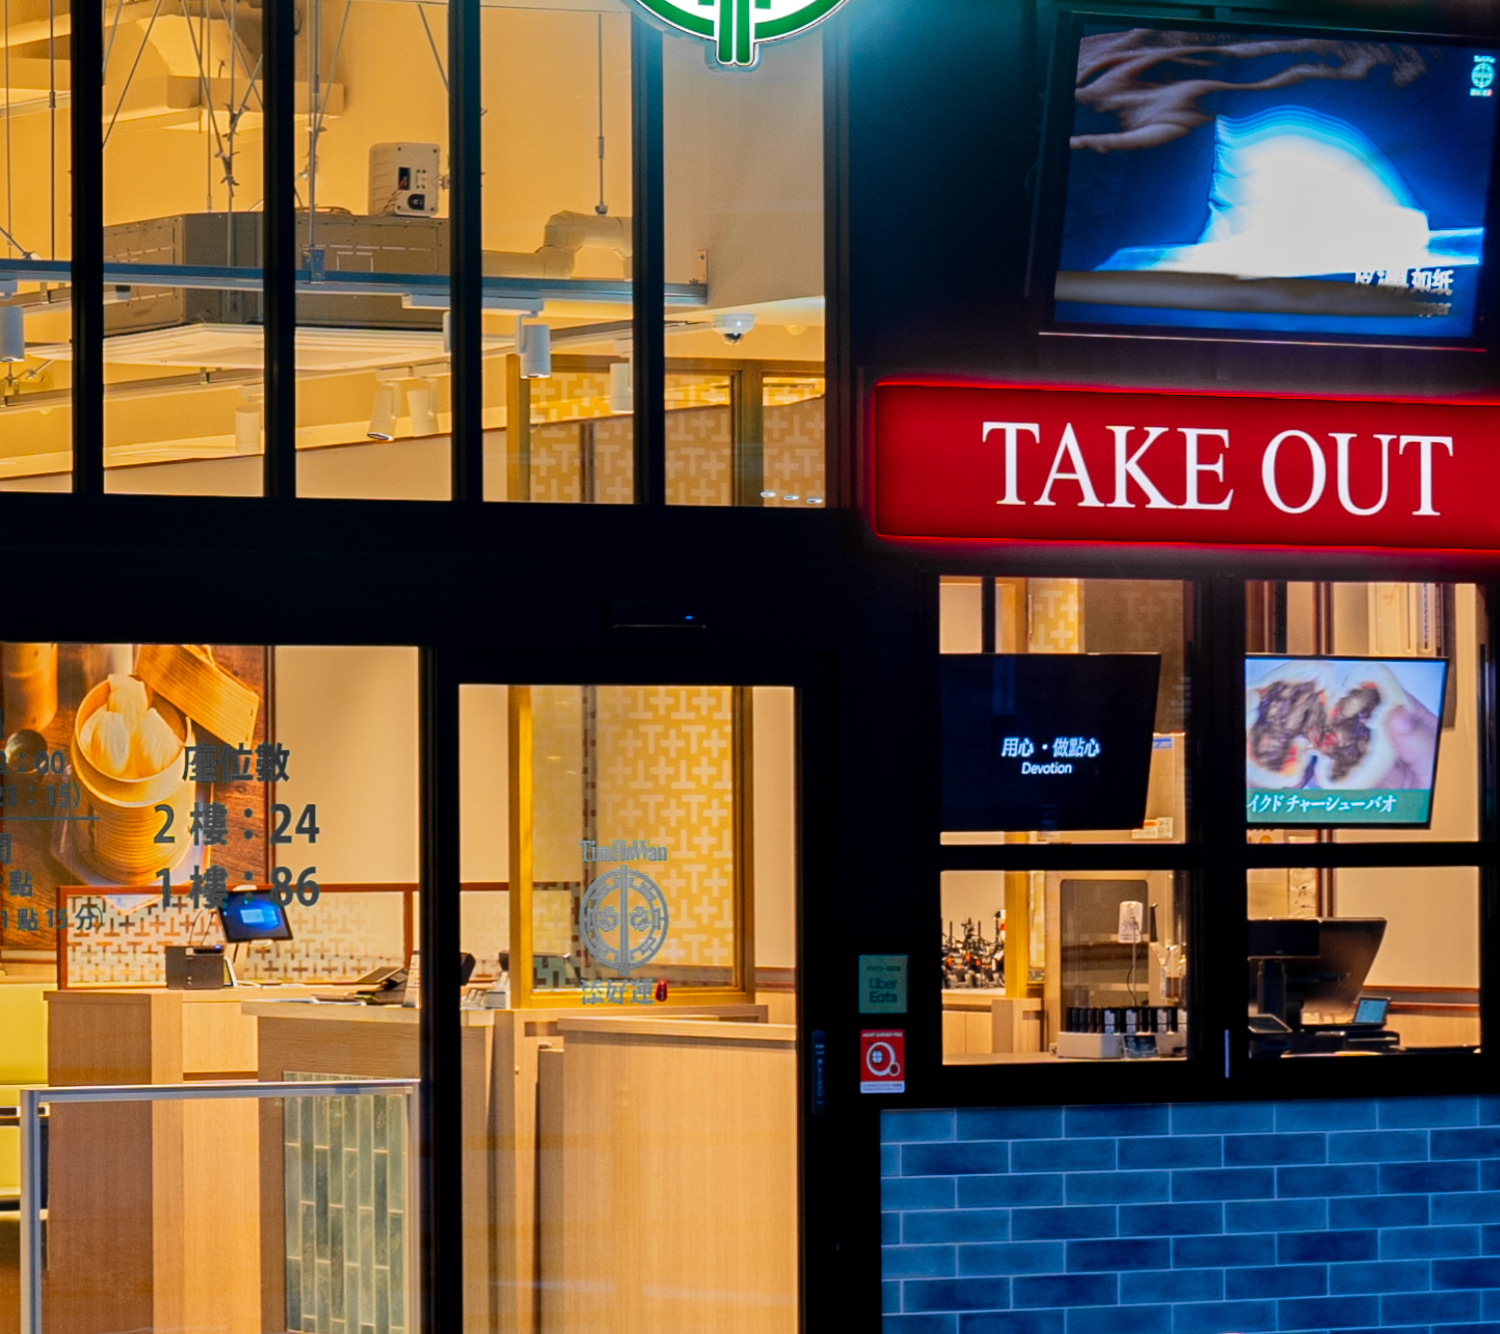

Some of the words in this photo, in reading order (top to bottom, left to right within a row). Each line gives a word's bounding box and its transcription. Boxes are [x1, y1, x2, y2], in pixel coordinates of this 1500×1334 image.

[981, 421, 1234, 511] TAKE
[1261, 429, 1454, 516] OUT
[182, 741, 290, 782] 座位數
[1021, 761, 1073, 775] Devotion
[578, 839, 668, 862] TimHoWan
[580, 978, 655, 1005] 添好運
[868, 976, 899, 990] Uber
[868, 990, 899, 1004] Eats
